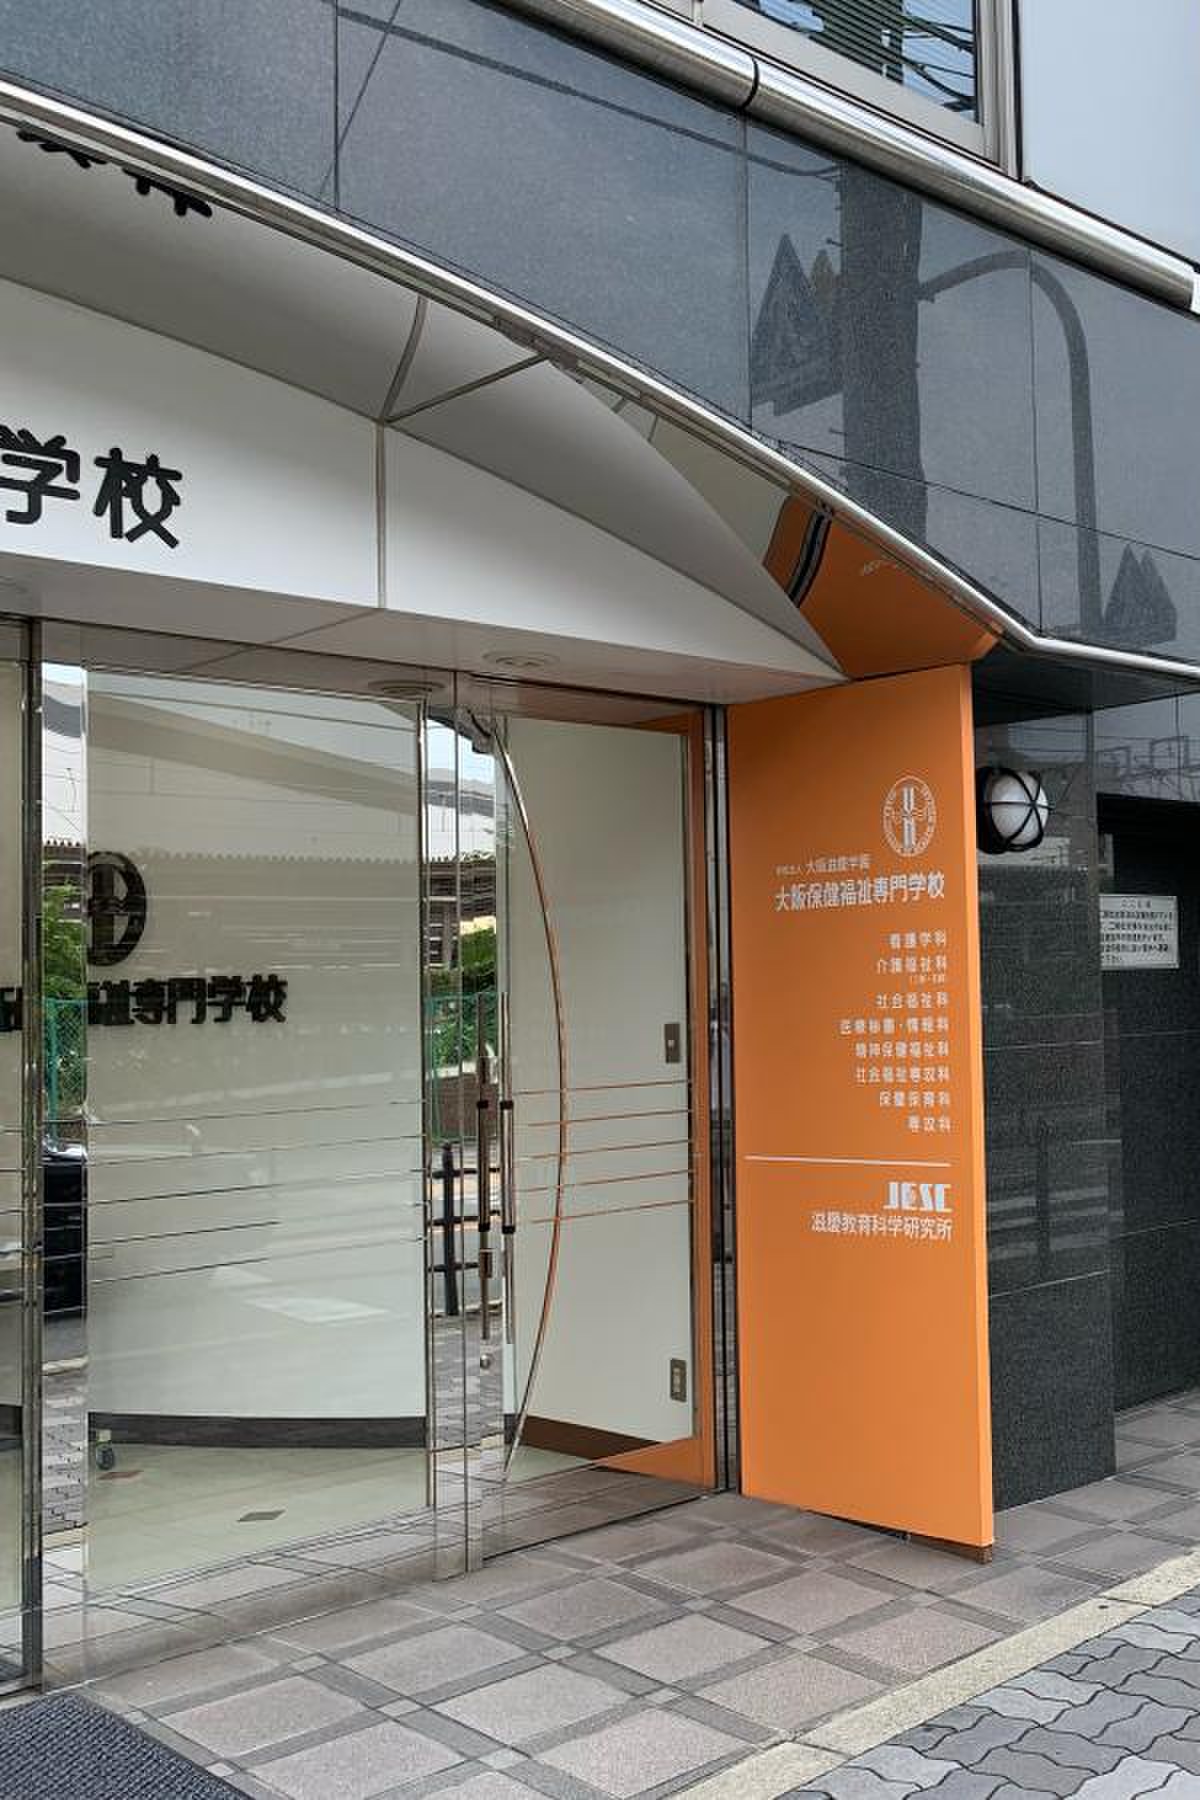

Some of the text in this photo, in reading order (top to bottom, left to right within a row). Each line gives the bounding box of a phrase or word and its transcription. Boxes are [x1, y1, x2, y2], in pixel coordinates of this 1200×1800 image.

[0, 424, 183, 549] 学校
[775, 871, 945, 912] 大阪保健福祉専門学校
